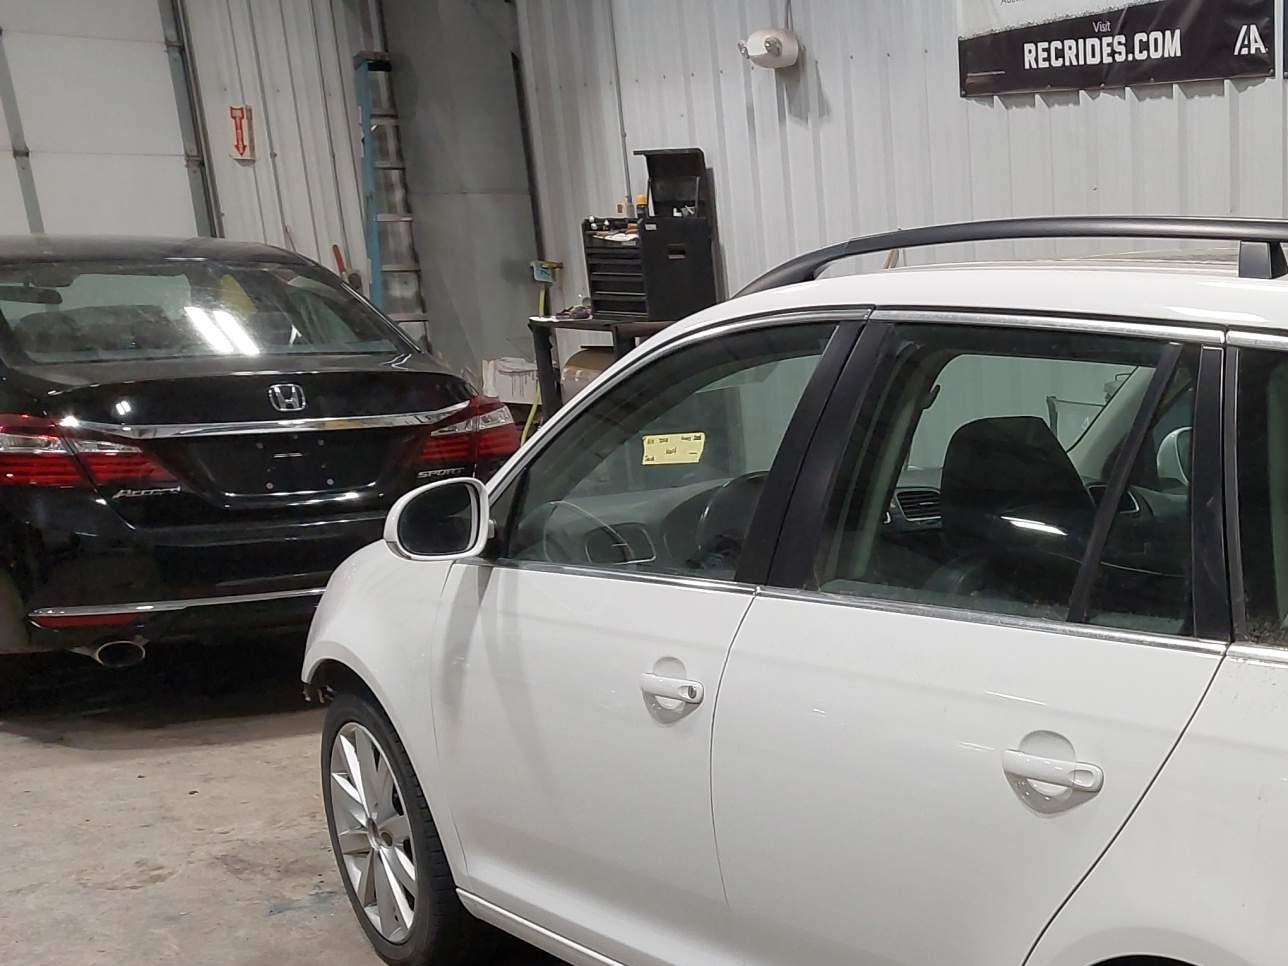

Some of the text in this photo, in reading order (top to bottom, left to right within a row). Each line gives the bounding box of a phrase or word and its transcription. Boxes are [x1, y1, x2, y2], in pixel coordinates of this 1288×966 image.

[1092, 21, 1111, 33] Visit
[1023, 28, 1182, 70] RECRIDES.COM
[416, 467, 465, 479] SPORT
[112, 485, 181, 500] Accord
